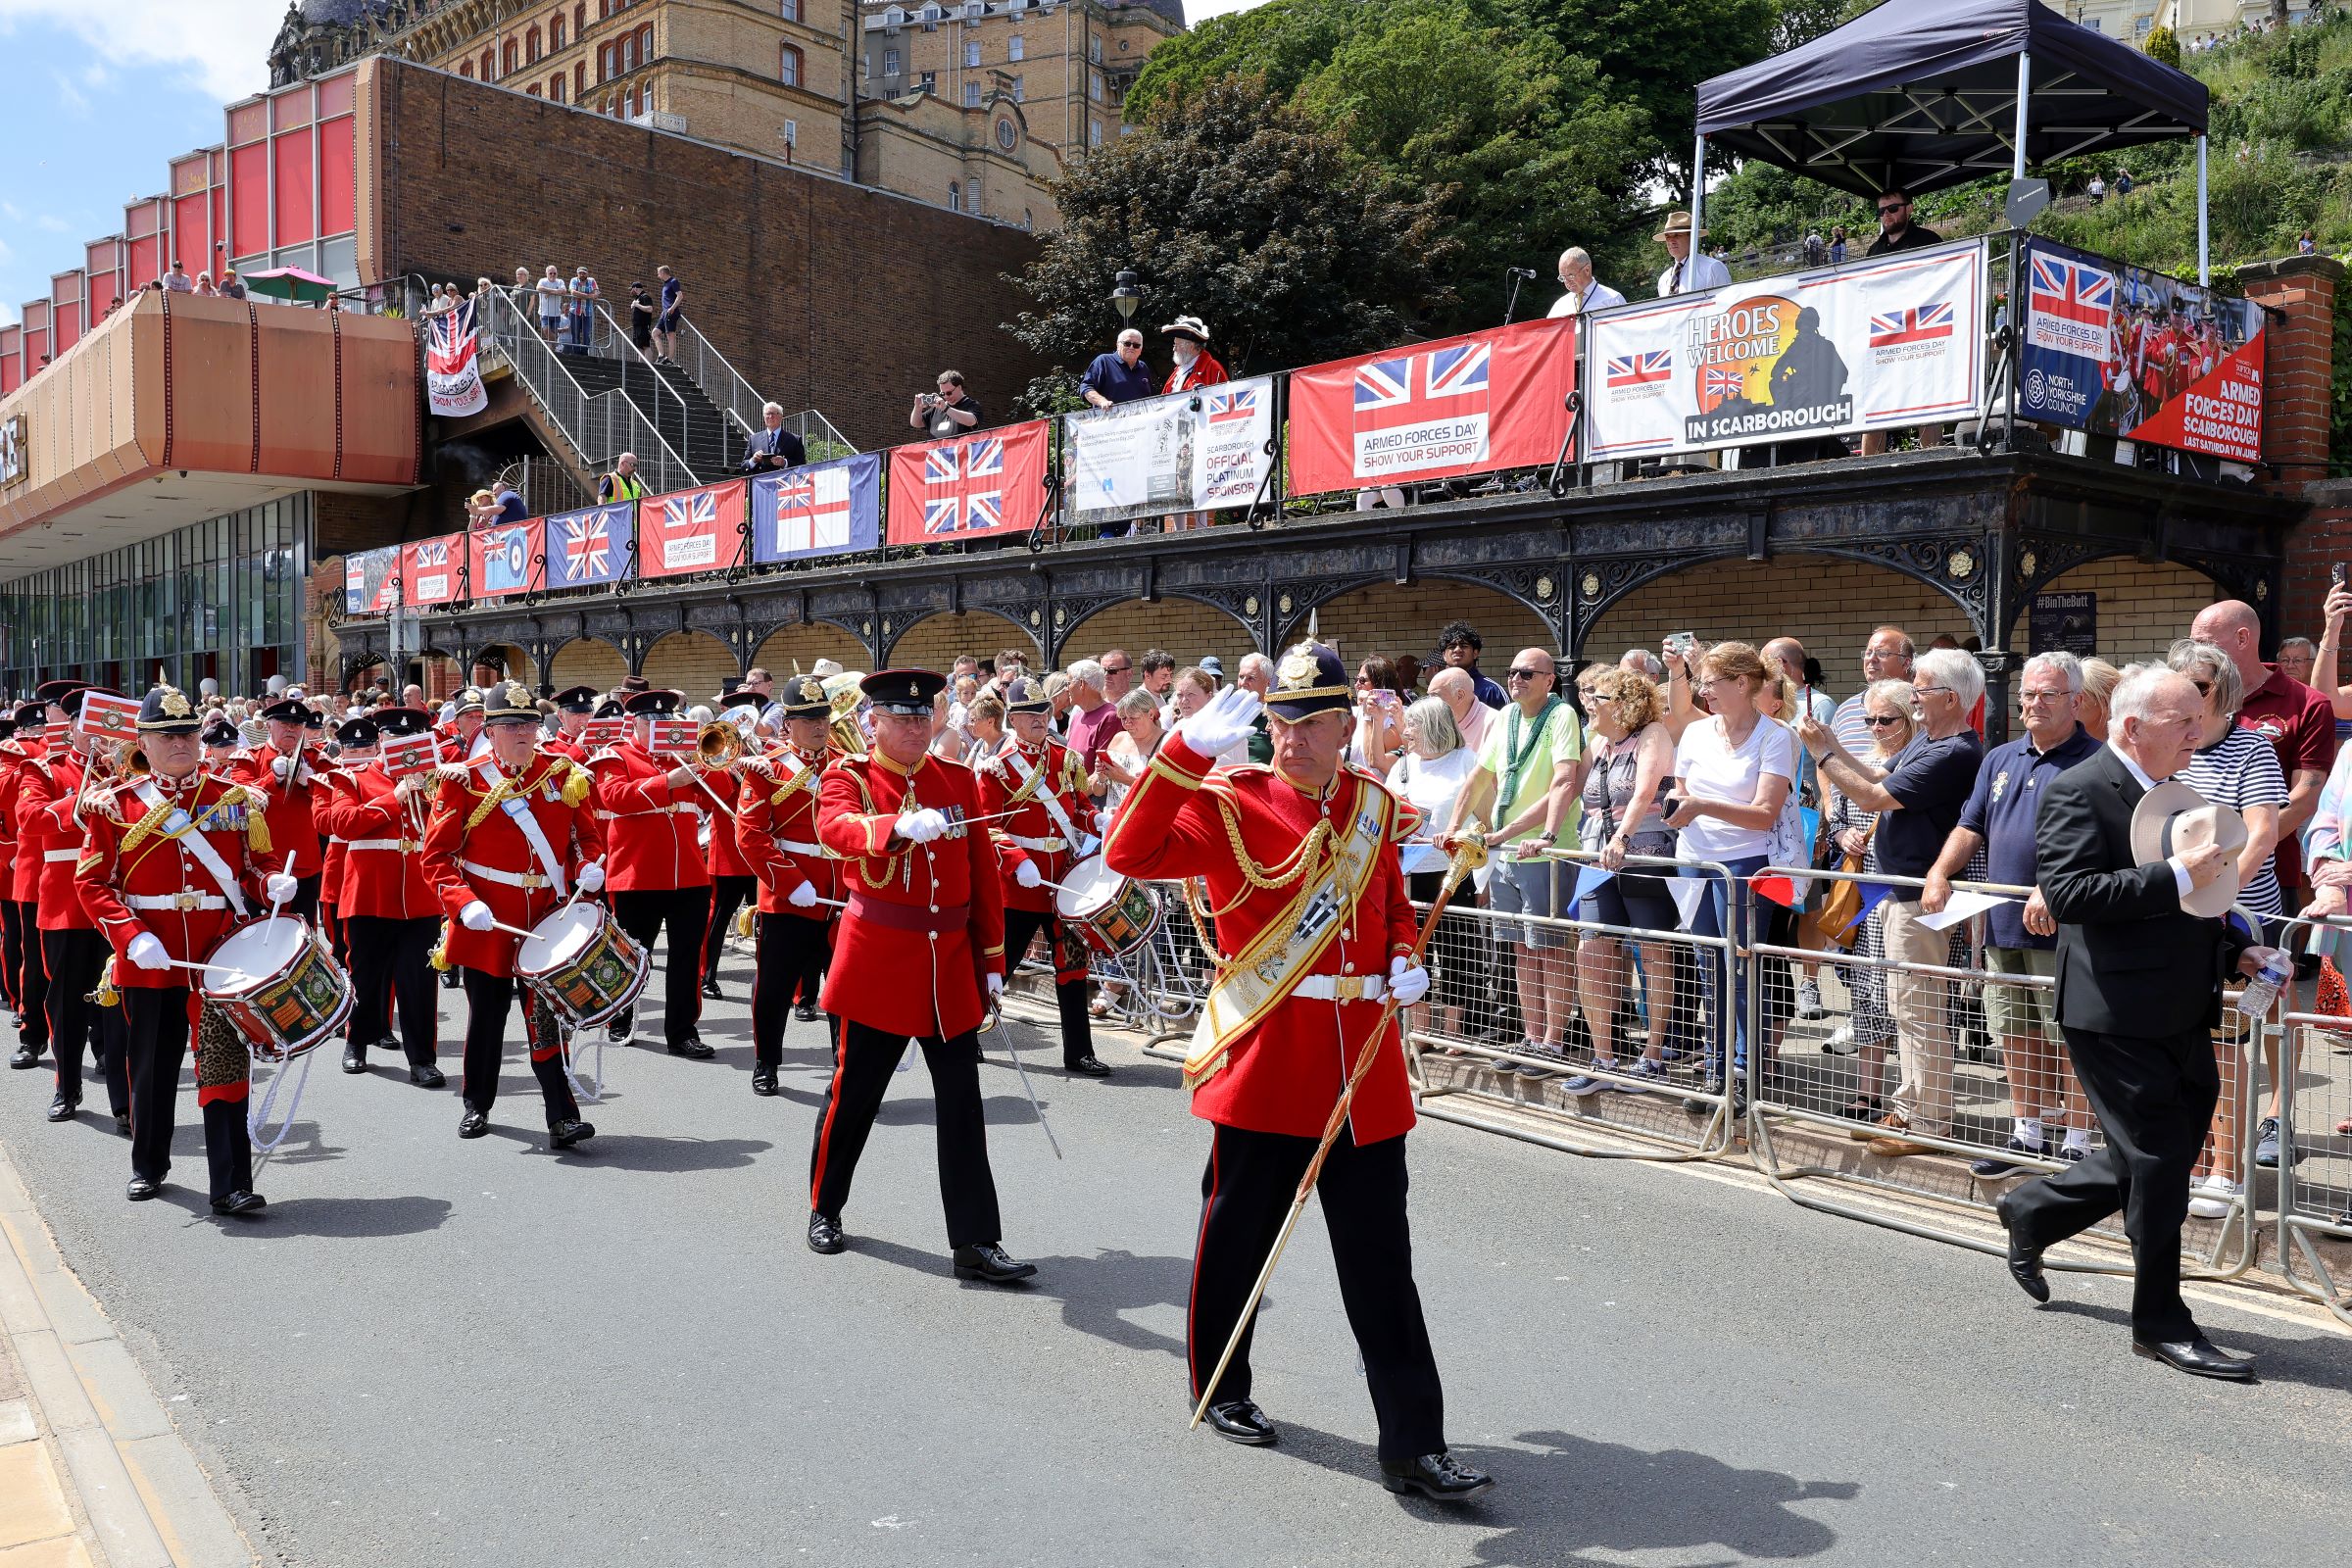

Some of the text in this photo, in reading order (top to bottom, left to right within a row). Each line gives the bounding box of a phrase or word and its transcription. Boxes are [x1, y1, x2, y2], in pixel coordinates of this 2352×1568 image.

[1688, 304, 1780, 347] HEROES
[2037, 318, 2103, 342] ARMED FORCES DAY
[1687, 335, 1780, 368] WELCOME
[1876, 348, 1901, 357] ARMED
[1902, 343, 1931, 352] FORCES
[2036, 330, 2103, 355] SHOW YOUR SUPPORT
[1915, 349, 1946, 360] SUPPORT
[2048, 374, 2074, 390] NORTH
[2048, 387, 2086, 405] YORKSHIRE
[2220, 380, 2260, 407] ARMED
[2048, 399, 2078, 416] COUNCIL
[2185, 393, 2260, 428] FORCES DAY
[1688, 402, 1851, 438] IN SCARBOROUGH
[1364, 421, 1478, 451] ARMED FORCES DAY
[2183, 416, 2258, 446] SCARBOROUGH
[1206, 440, 1254, 454] SCARBOROUGH
[1364, 441, 1478, 468] SHOW YOUR SUPPORT
[2184, 435, 2257, 461] LAST SATURDAY IN JUNE
[1206, 452, 1254, 469] OFFICIAL
[1206, 467, 1254, 484] PLATINUM
[1207, 482, 1255, 499] SPONSOR
[684, 540, 702, 550] FORCES
[702, 539, 712, 548] DAY
[2036, 595, 2088, 609] #BinTheButt
